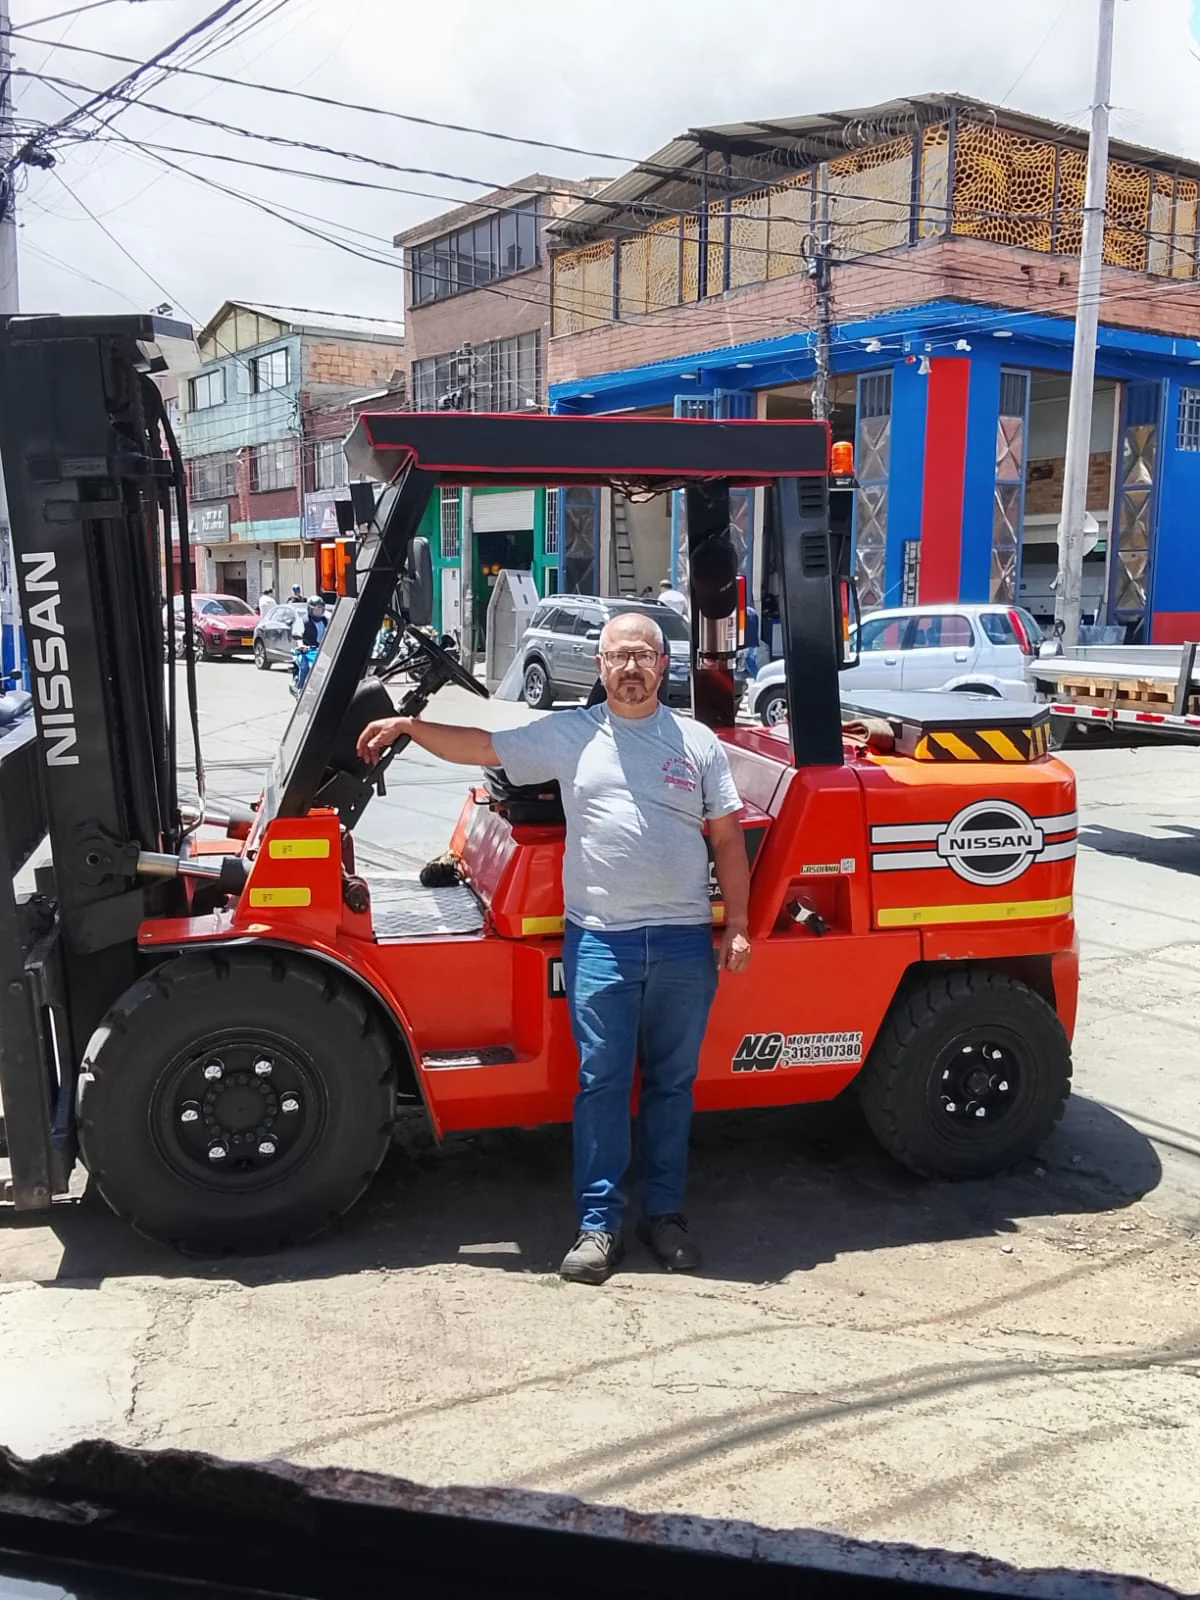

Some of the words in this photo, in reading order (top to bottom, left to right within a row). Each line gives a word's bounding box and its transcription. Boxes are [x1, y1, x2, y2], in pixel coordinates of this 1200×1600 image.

[21, 552, 80, 766] NISSAN
[949, 835, 1033, 850] NISSAN
[735, 1034, 783, 1059] NG
[788, 1033, 860, 1045] MONTACARGAS
[791, 1046, 811, 1059] 313
[814, 1044, 860, 1058] 3107380
